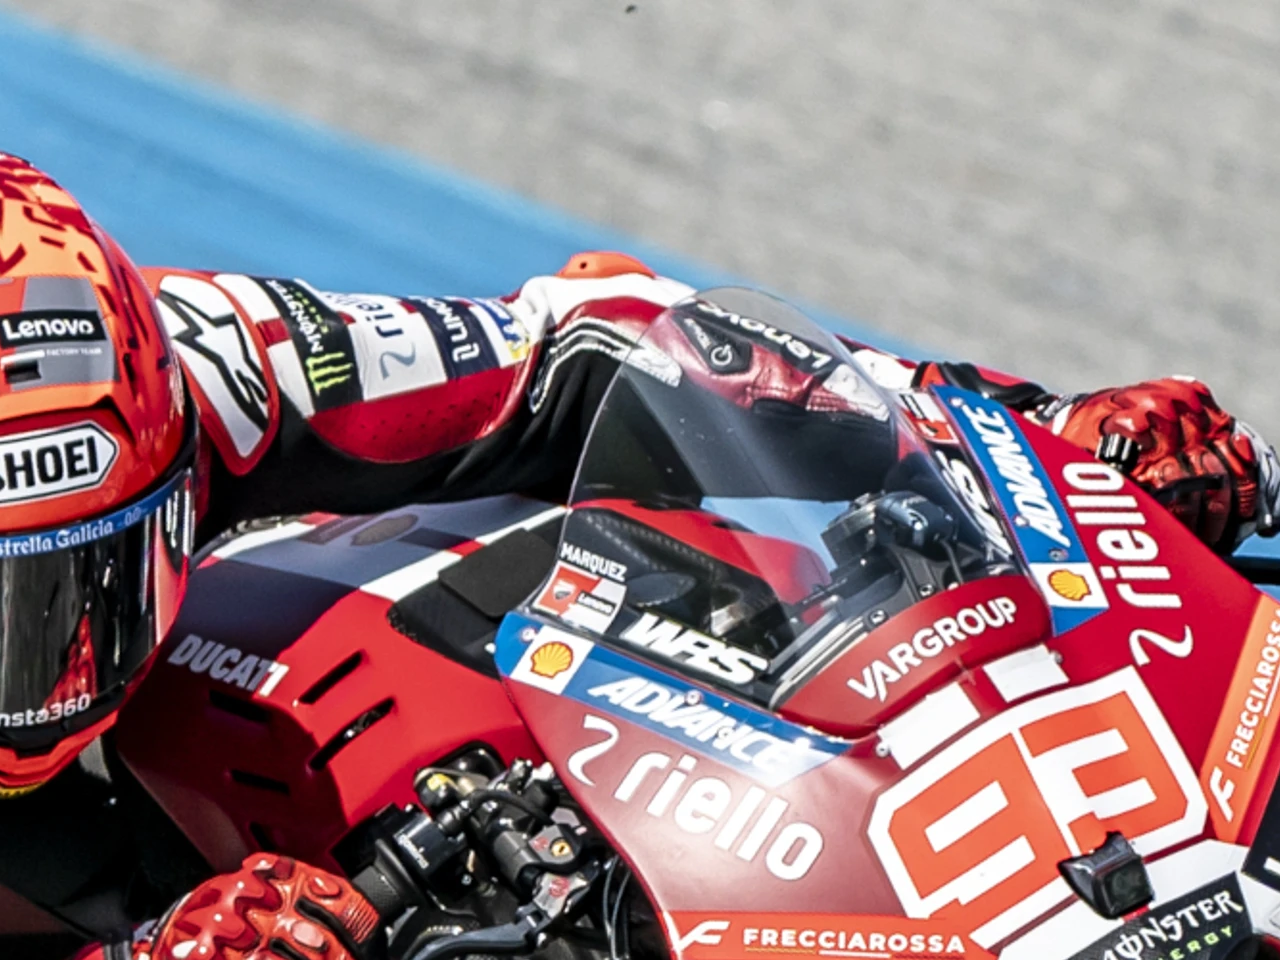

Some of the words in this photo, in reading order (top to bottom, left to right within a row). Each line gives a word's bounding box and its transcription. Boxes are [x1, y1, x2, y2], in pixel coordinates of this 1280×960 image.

[1, 317, 95, 339] Lenovo
[961, 403, 1071, 548] ADVANCE
[56, 519, 114, 549] Galicia
[560, 541, 628, 583] MARQUEZ
[1062, 461, 1183, 609] riello
[167, 635, 289, 697] DUCATI
[623, 612, 771, 685] WRS
[847, 597, 1019, 702] VARGROUP
[586, 675, 809, 774] ADVANCE
[613, 749, 825, 882] riello
[888, 690, 1189, 948] 93
[743, 927, 966, 954] FRECCIAROSSA
